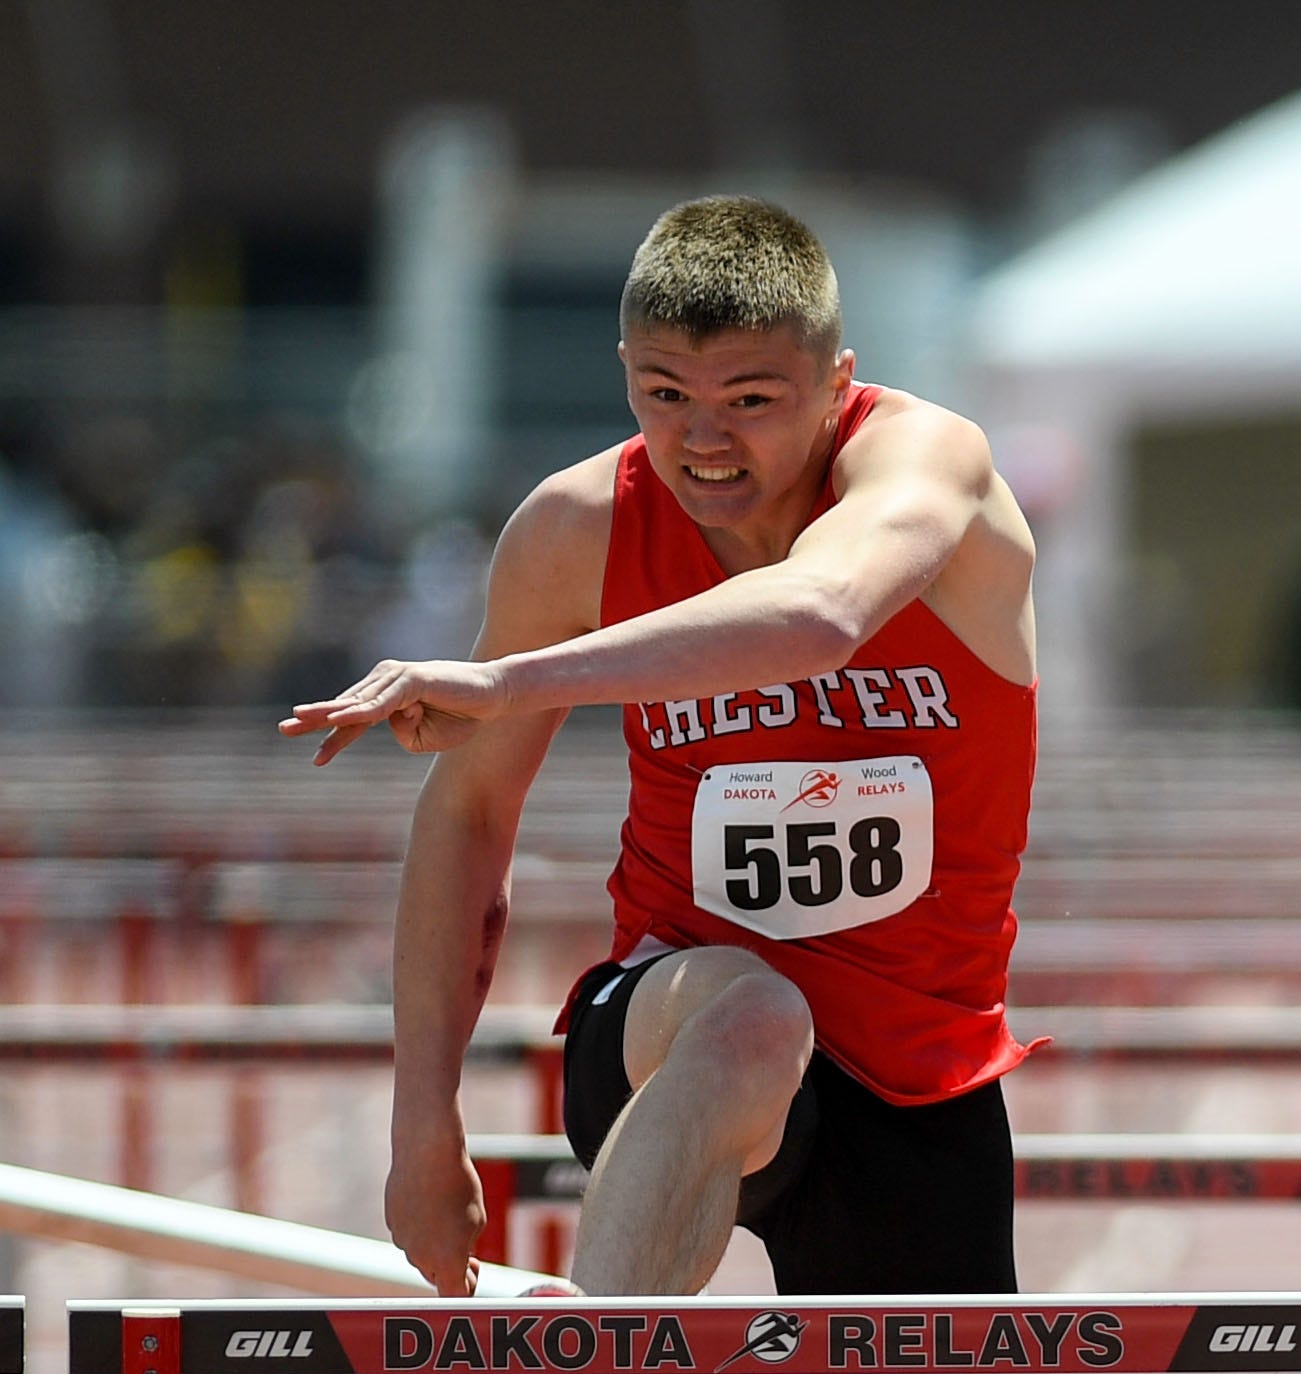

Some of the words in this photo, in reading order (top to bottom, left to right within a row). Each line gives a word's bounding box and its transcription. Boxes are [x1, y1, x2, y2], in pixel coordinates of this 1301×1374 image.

[723, 787, 777, 801] DAKOTA
[857, 782, 905, 796] RELAYS
[728, 770, 773, 783] Howard
[861, 765, 897, 780] Wood
[723, 816, 902, 911] 558
[224, 1330, 314, 1358] GILL
[383, 1315, 696, 1371] DAKOTA
[827, 1312, 1125, 1368] RELAYS
[1208, 1325, 1297, 1352] GILL
